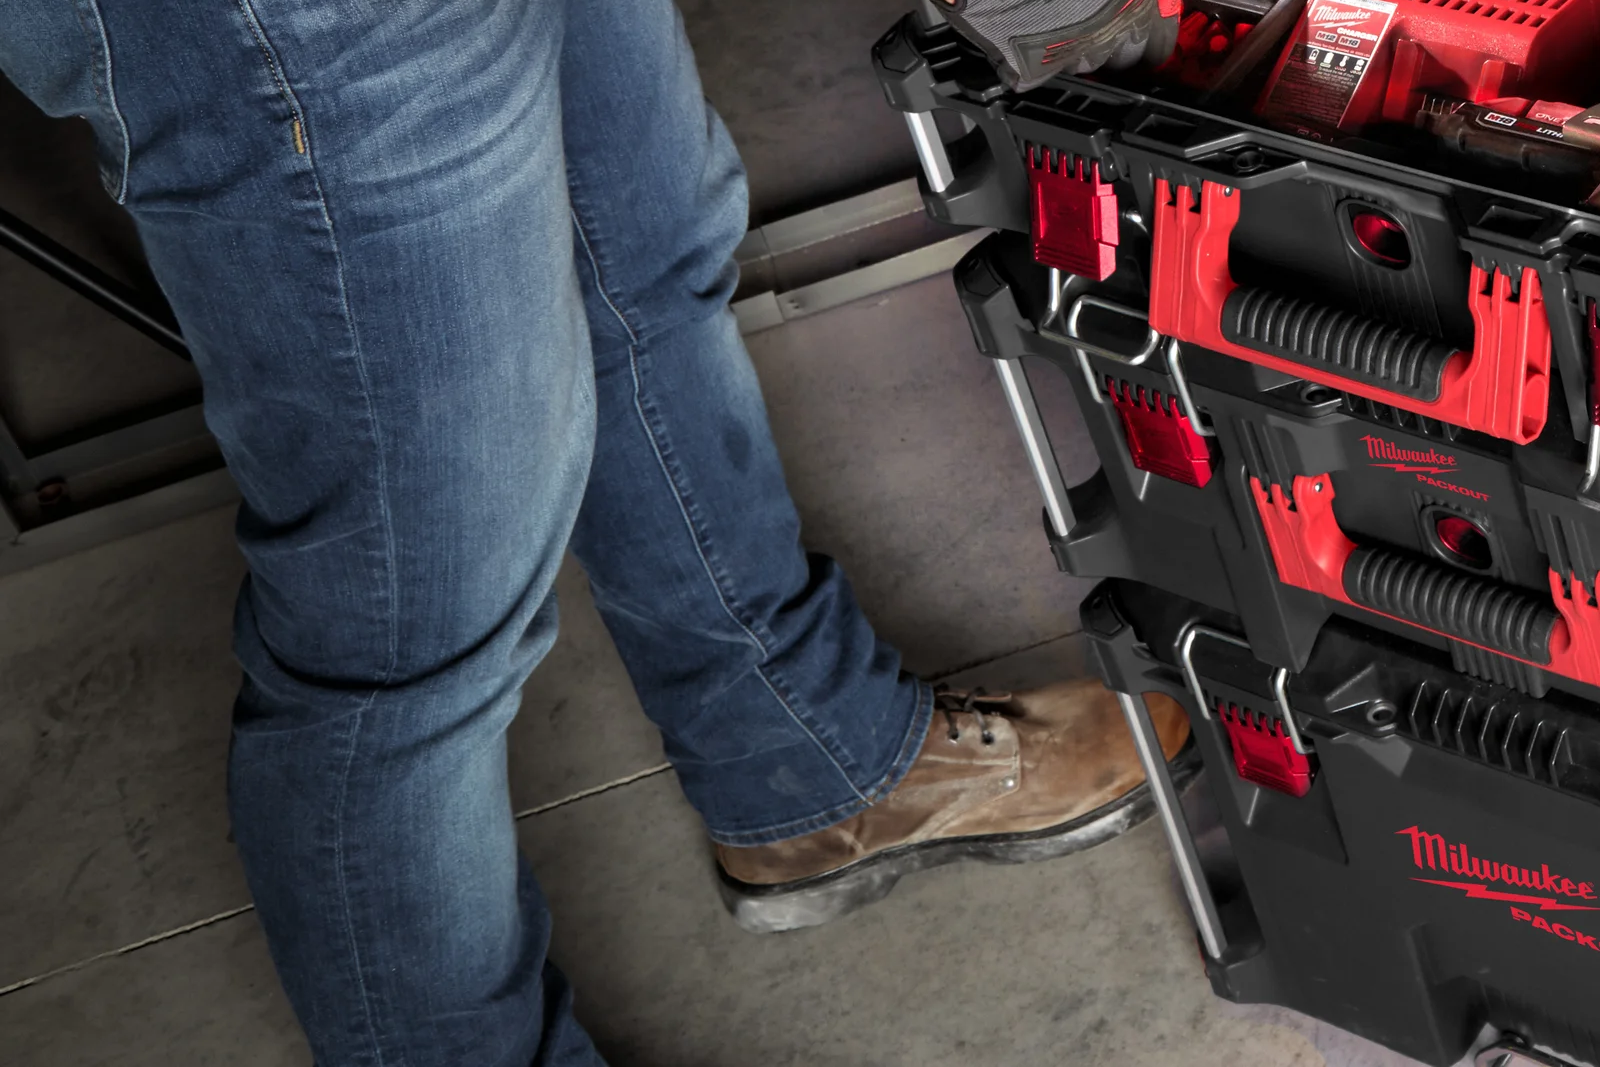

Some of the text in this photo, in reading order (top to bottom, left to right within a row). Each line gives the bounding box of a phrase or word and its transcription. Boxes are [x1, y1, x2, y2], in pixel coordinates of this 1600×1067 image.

[1313, 5, 1372, 22] Milwaukee
[1336, 27, 1379, 42] CHARGER
[1485, 113, 1515, 126] M18
[1359, 433, 1458, 466] Milwaukee
[1415, 473, 1492, 502] PACKOUT
[1395, 825, 1598, 900] Milwaukee
